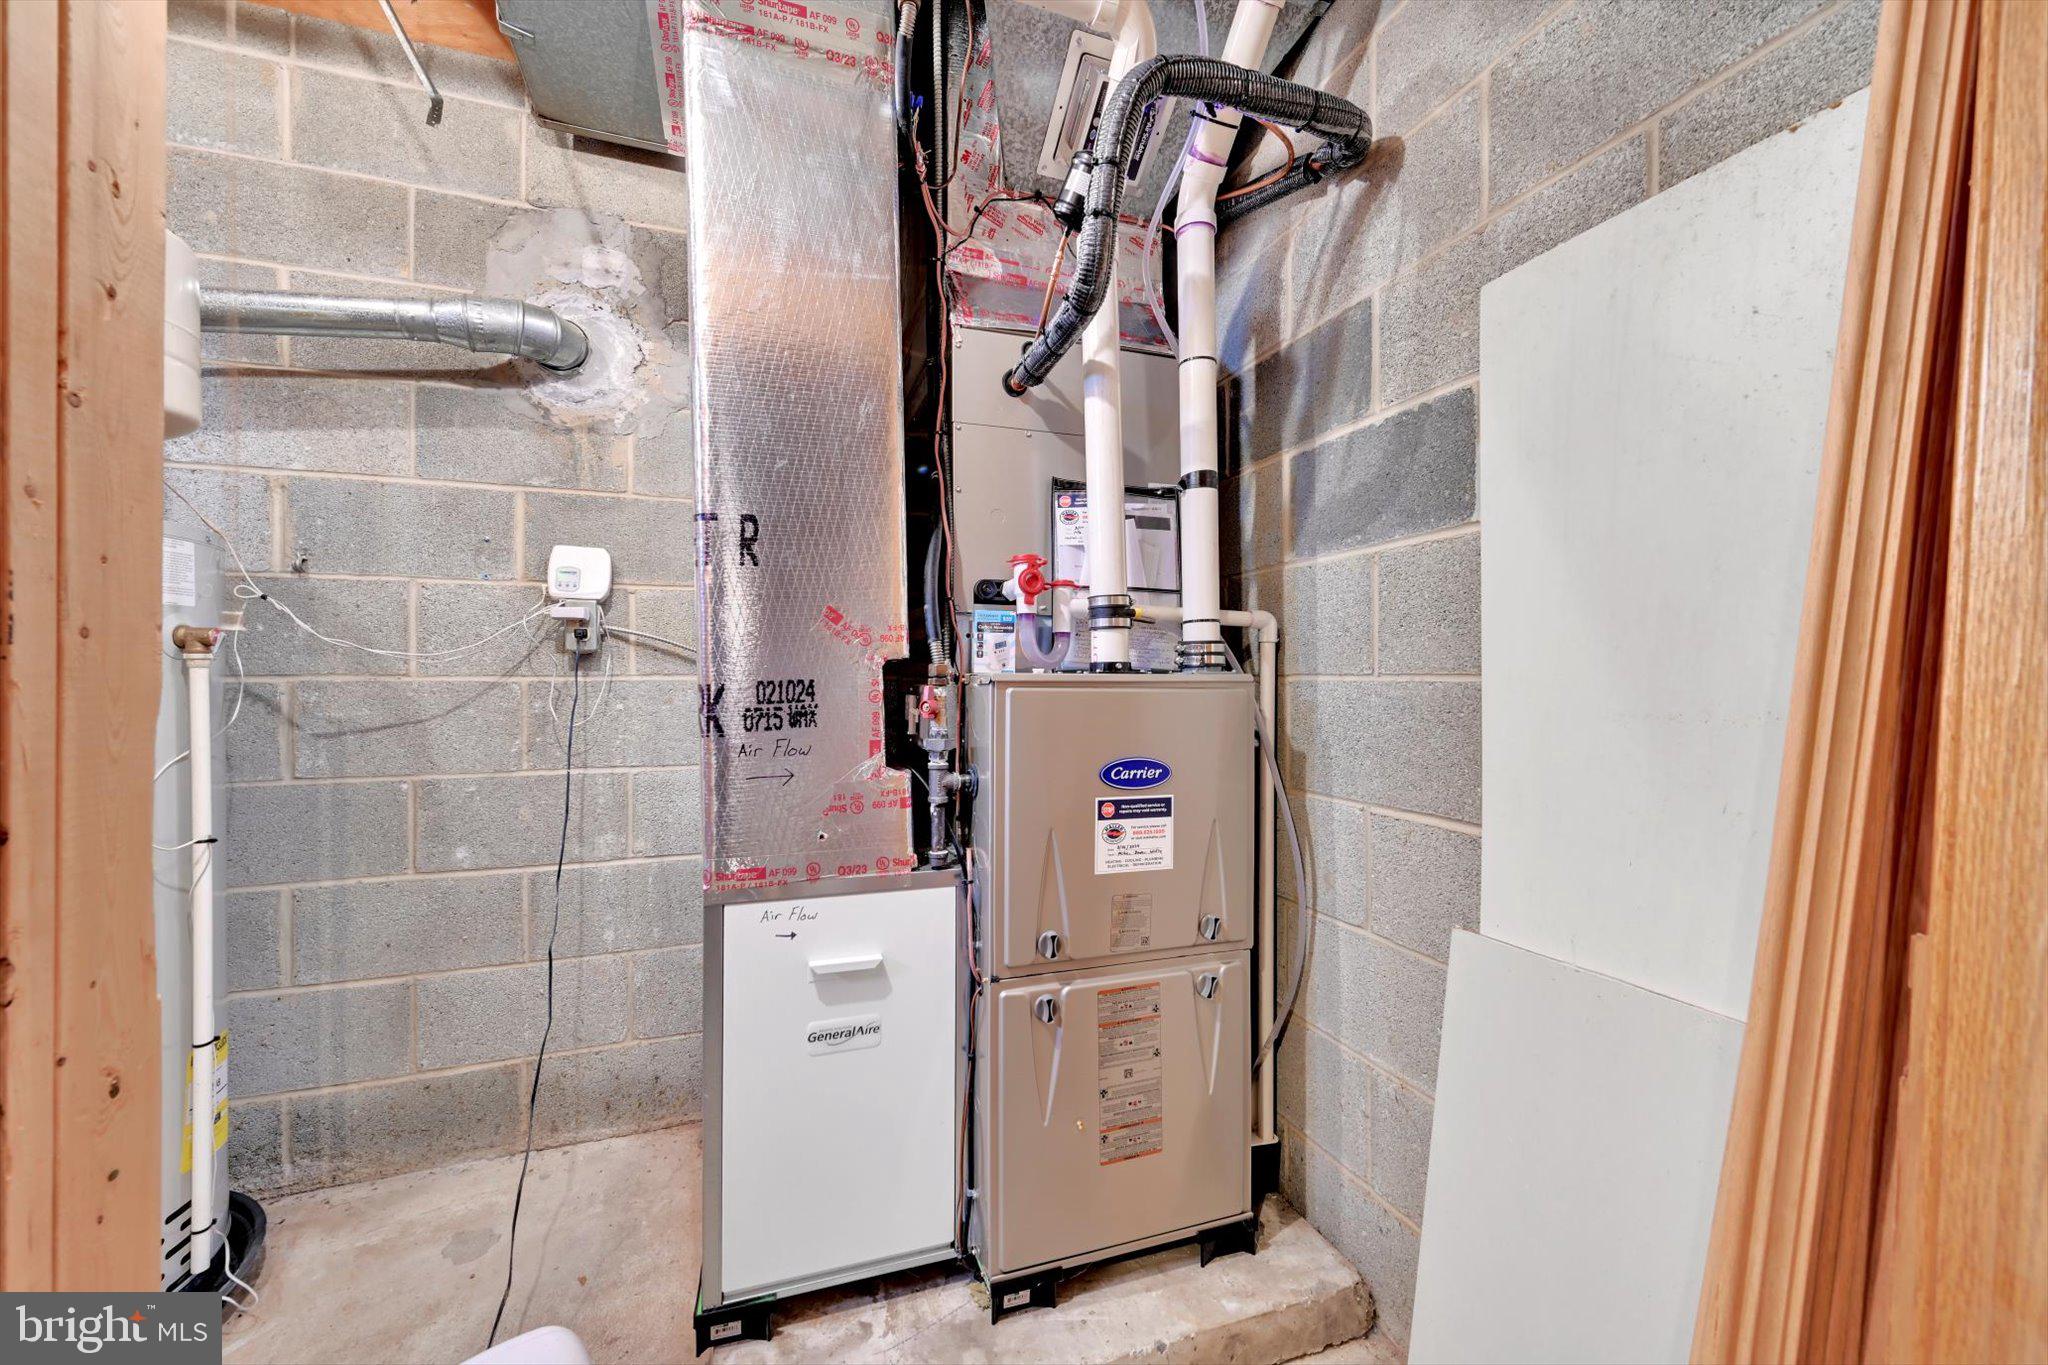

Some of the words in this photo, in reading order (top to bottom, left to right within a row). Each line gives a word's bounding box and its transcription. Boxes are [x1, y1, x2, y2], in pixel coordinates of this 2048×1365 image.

[810, 11, 820, 20] AF
[822, 14, 837, 25] 099
[826, 49, 856, 67] Q3/23
[739, 513, 760, 567] R
[756, 679, 816, 705] 021024
[743, 706, 784, 733] 0715
[738, 743, 763, 758] Air
[773, 738, 812, 760] Flow
[1110, 766, 1163, 780] Carrier
[769, 869, 780, 878] AF
[783, 867, 797, 877] 099
[837, 864, 868, 877] Q3/23
[760, 910, 782, 924] Air
[788, 905, 819, 922] Flow
[807, 1024, 880, 1043] GeneralAire
